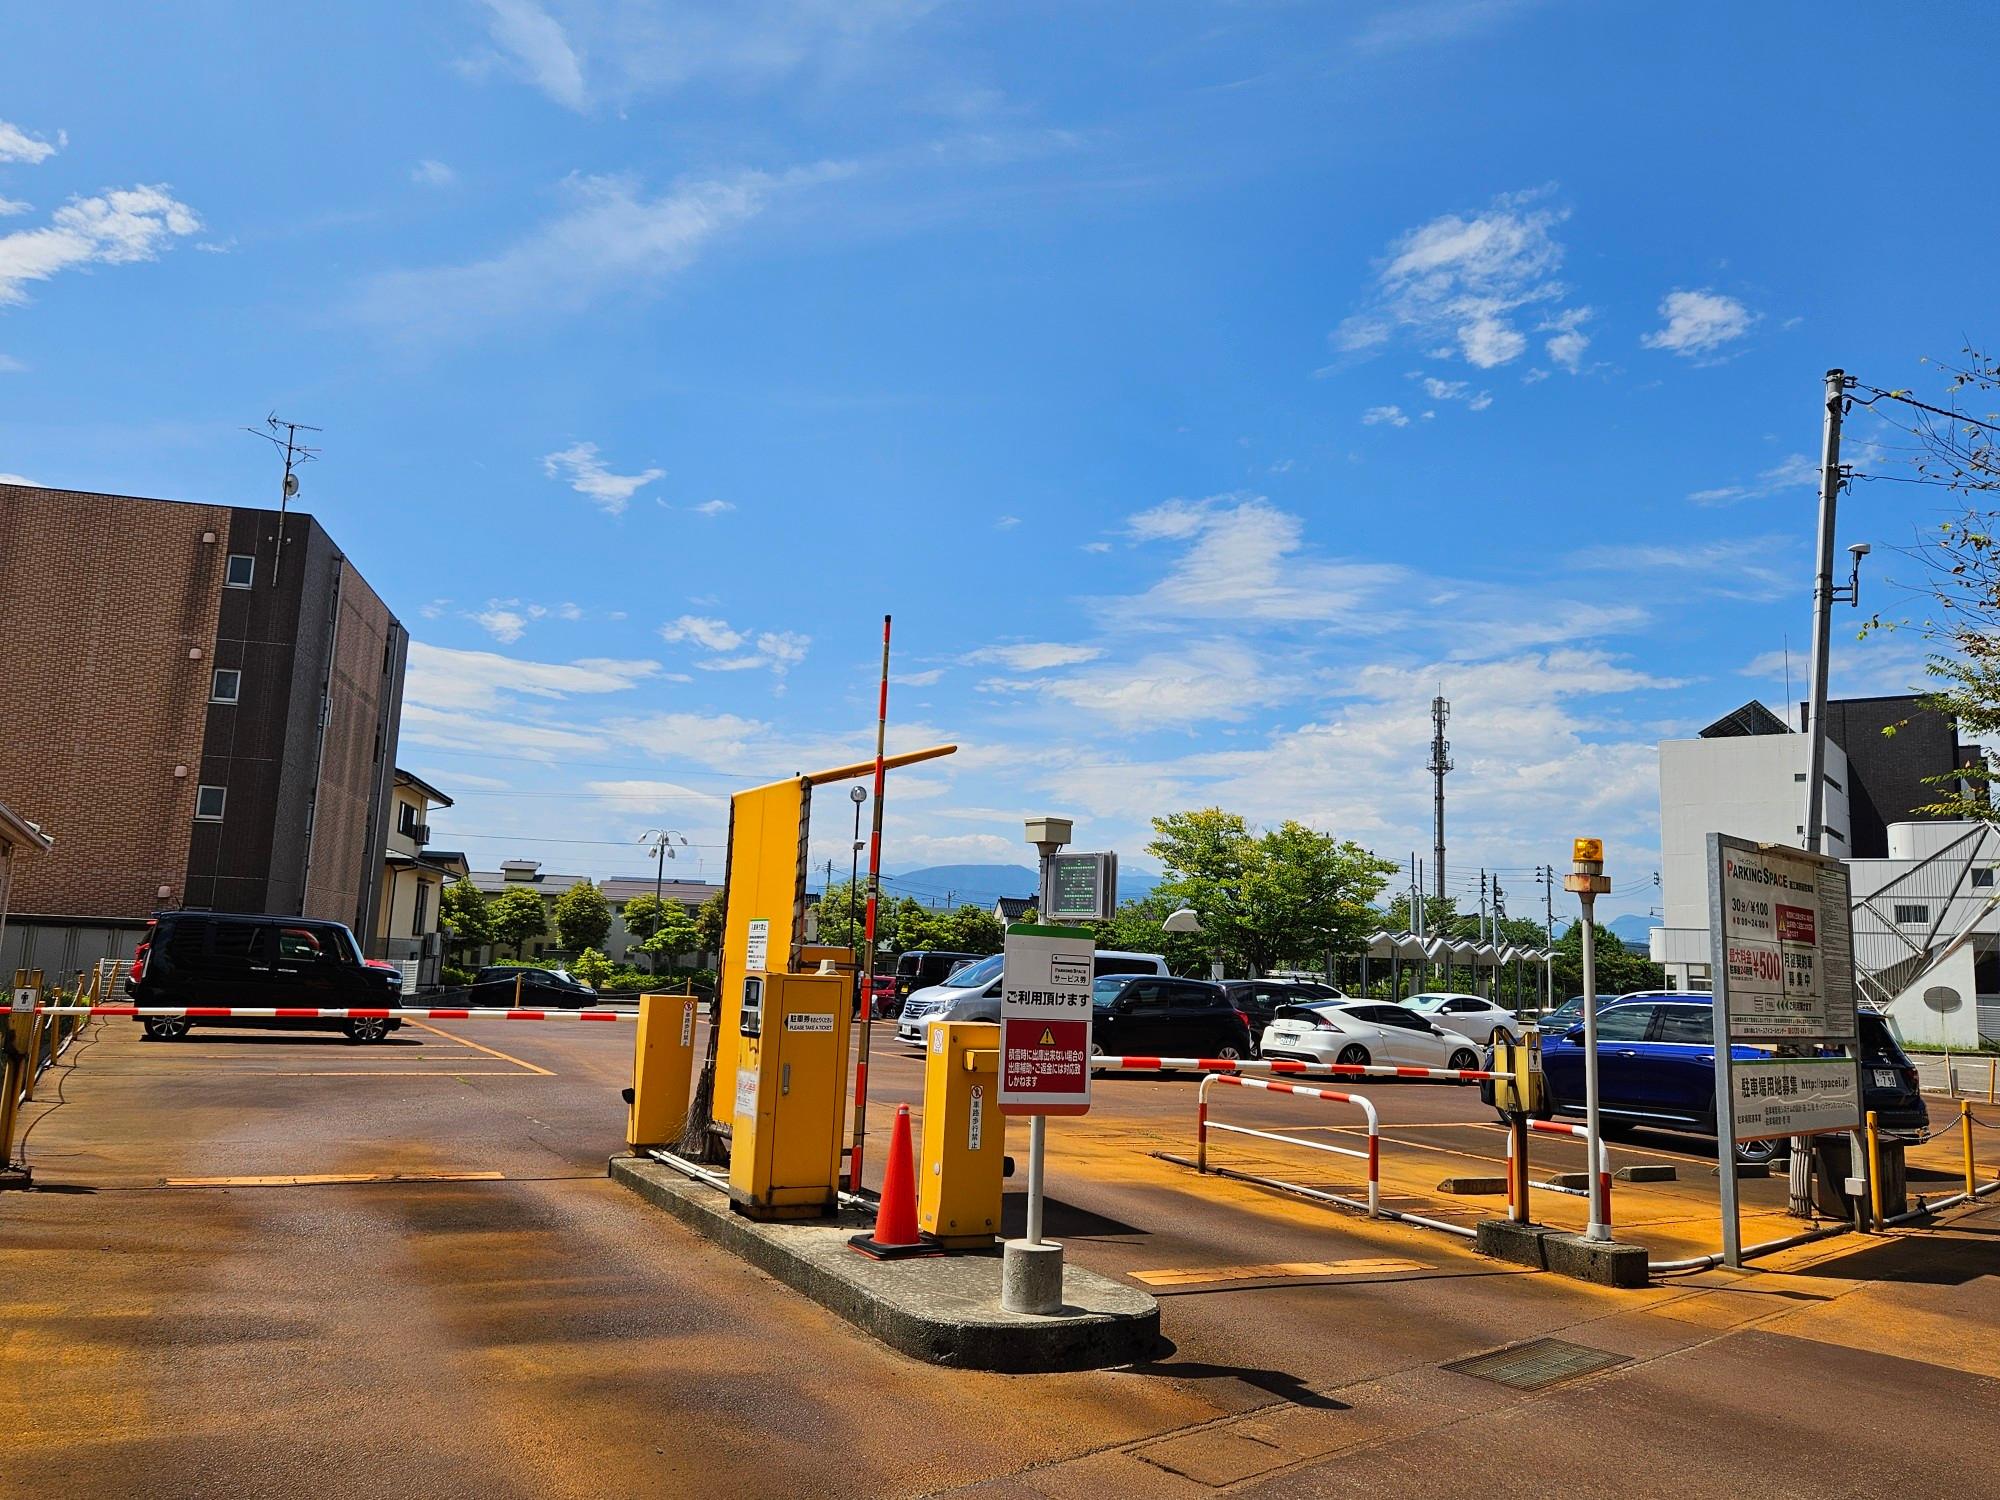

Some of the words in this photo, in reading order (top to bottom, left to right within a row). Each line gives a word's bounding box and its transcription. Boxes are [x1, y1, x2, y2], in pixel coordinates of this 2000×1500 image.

[1727, 860, 1762, 883] PARKING
[1763, 868, 1788, 889] SPACE
[1729, 948, 1752, 964] 最大料金
[1054, 975, 1087, 984] サービス券
[1006, 990, 1090, 1007] ご利用頂けます
[1008, 1049, 1084, 1062] 積雪時に出庫出来ない場合の
[1008, 1076, 1038, 1087] しかねます
[1741, 1075, 1798, 1098] 駐車場用地募集
[971, 1101, 979, 1149] 車路歩行禁止
